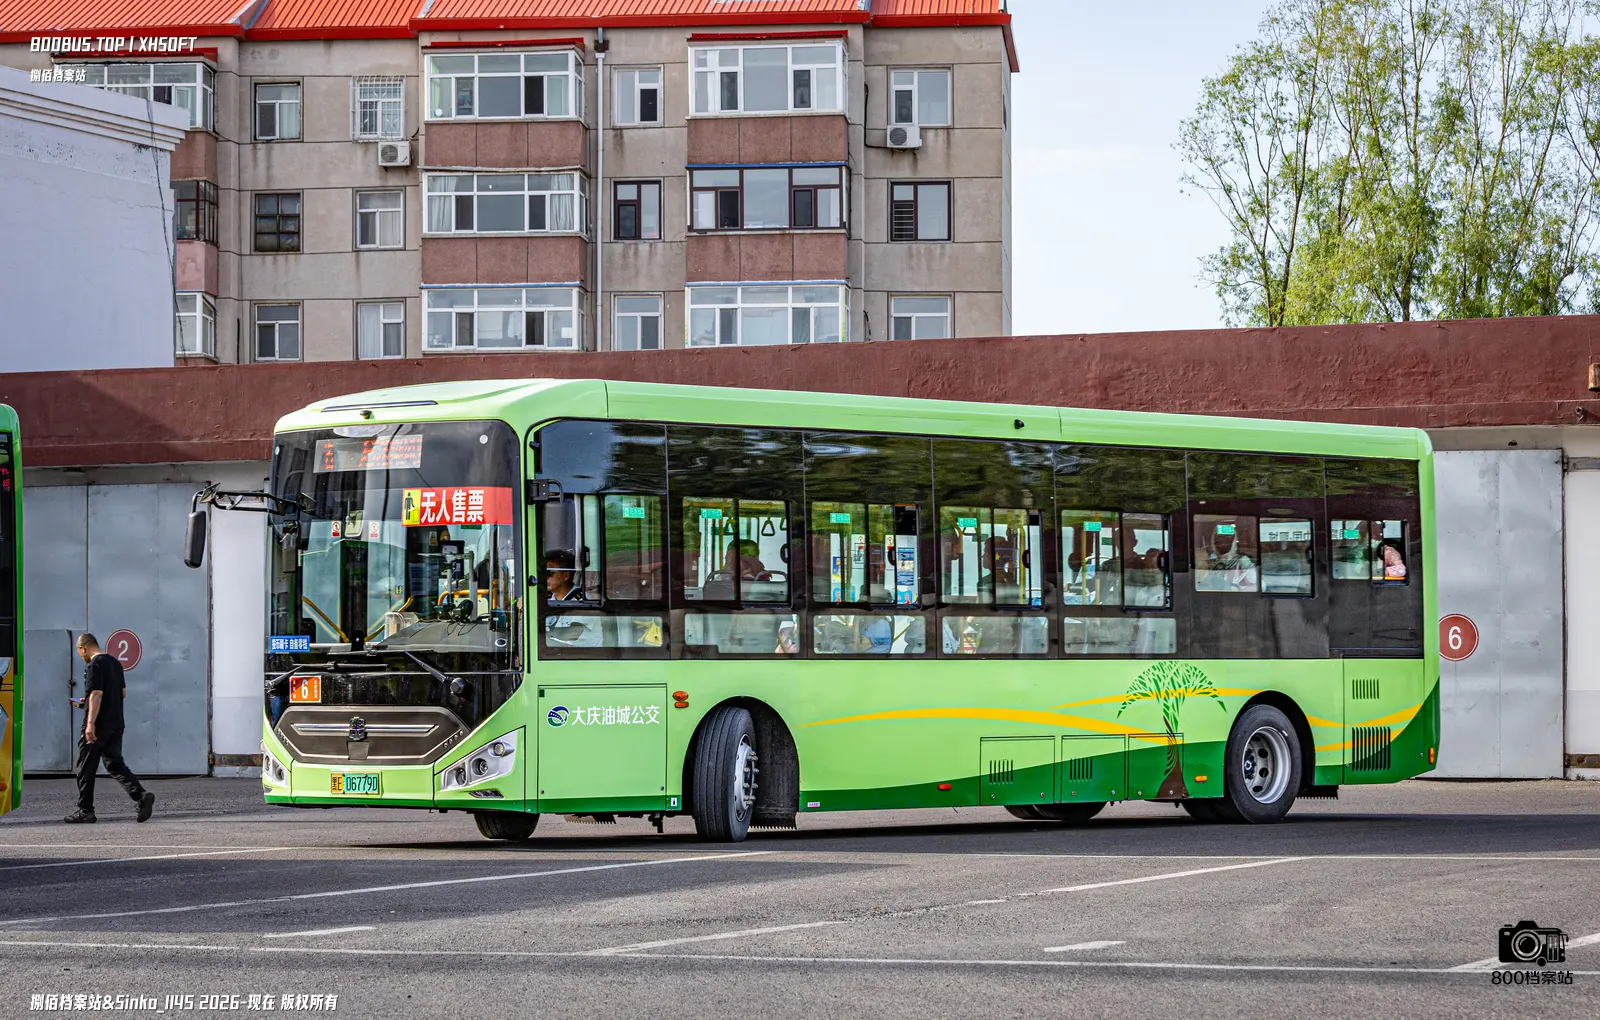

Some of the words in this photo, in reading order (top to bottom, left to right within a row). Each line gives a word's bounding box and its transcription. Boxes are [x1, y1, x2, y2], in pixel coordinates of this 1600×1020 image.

[421, 489, 484, 523] 无人售票
[1448, 626, 1462, 650] 6
[118, 640, 128, 661] 2
[301, 679, 309, 700] 6
[571, 705, 660, 726] 大庆油城公交
